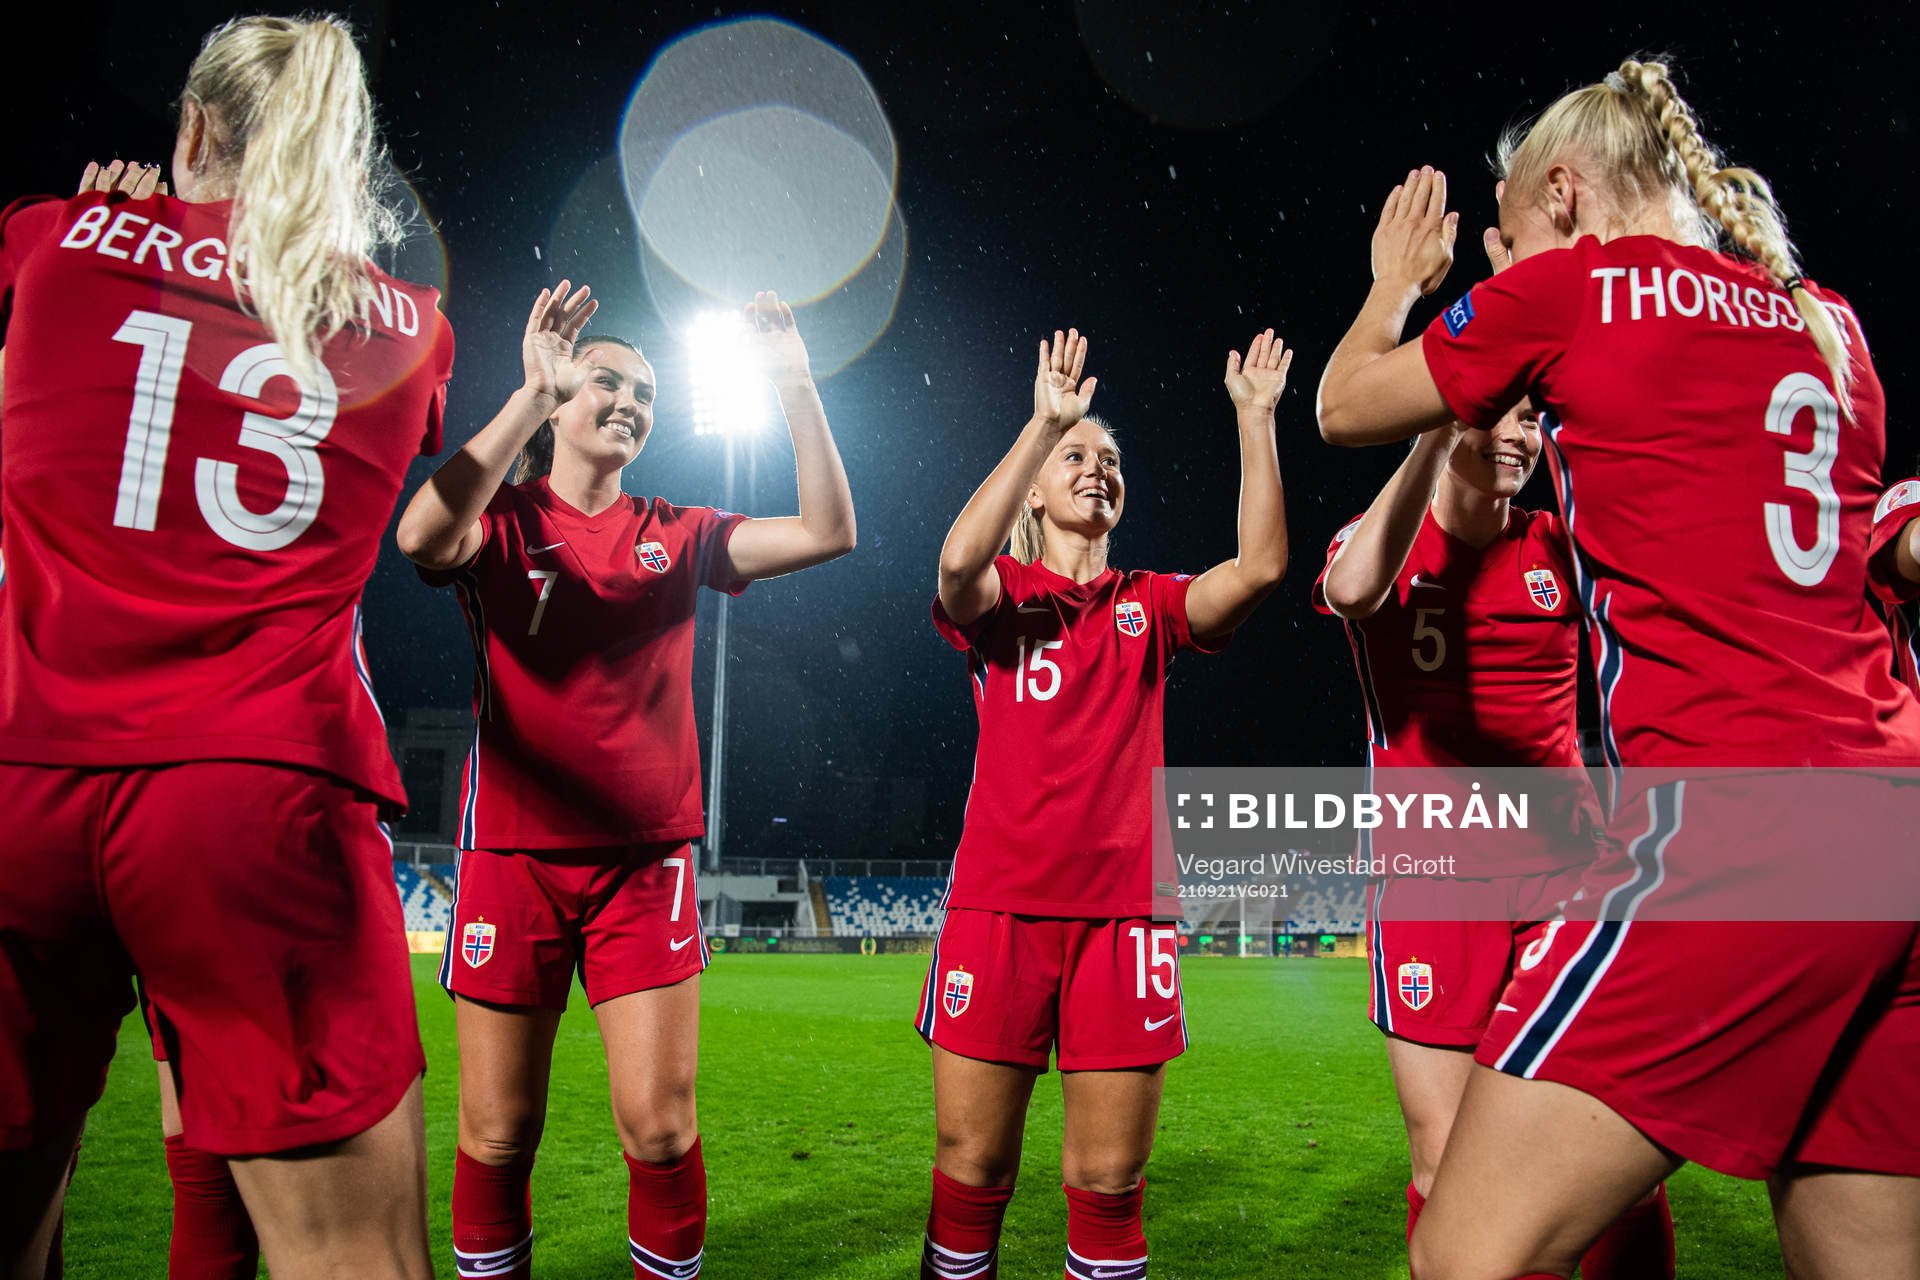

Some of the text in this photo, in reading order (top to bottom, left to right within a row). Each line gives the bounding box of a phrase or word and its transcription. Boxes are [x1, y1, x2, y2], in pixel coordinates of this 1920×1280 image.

[61, 205, 419, 337] BERGND
[111, 309, 339, 551] 13
[1764, 372, 1841, 586] 3
[528, 570, 559, 635] 7
[1016, 635, 1064, 702] 15
[1411, 608, 1447, 672] 5
[662, 858, 686, 922] 7
[1129, 927, 1176, 999] 15
